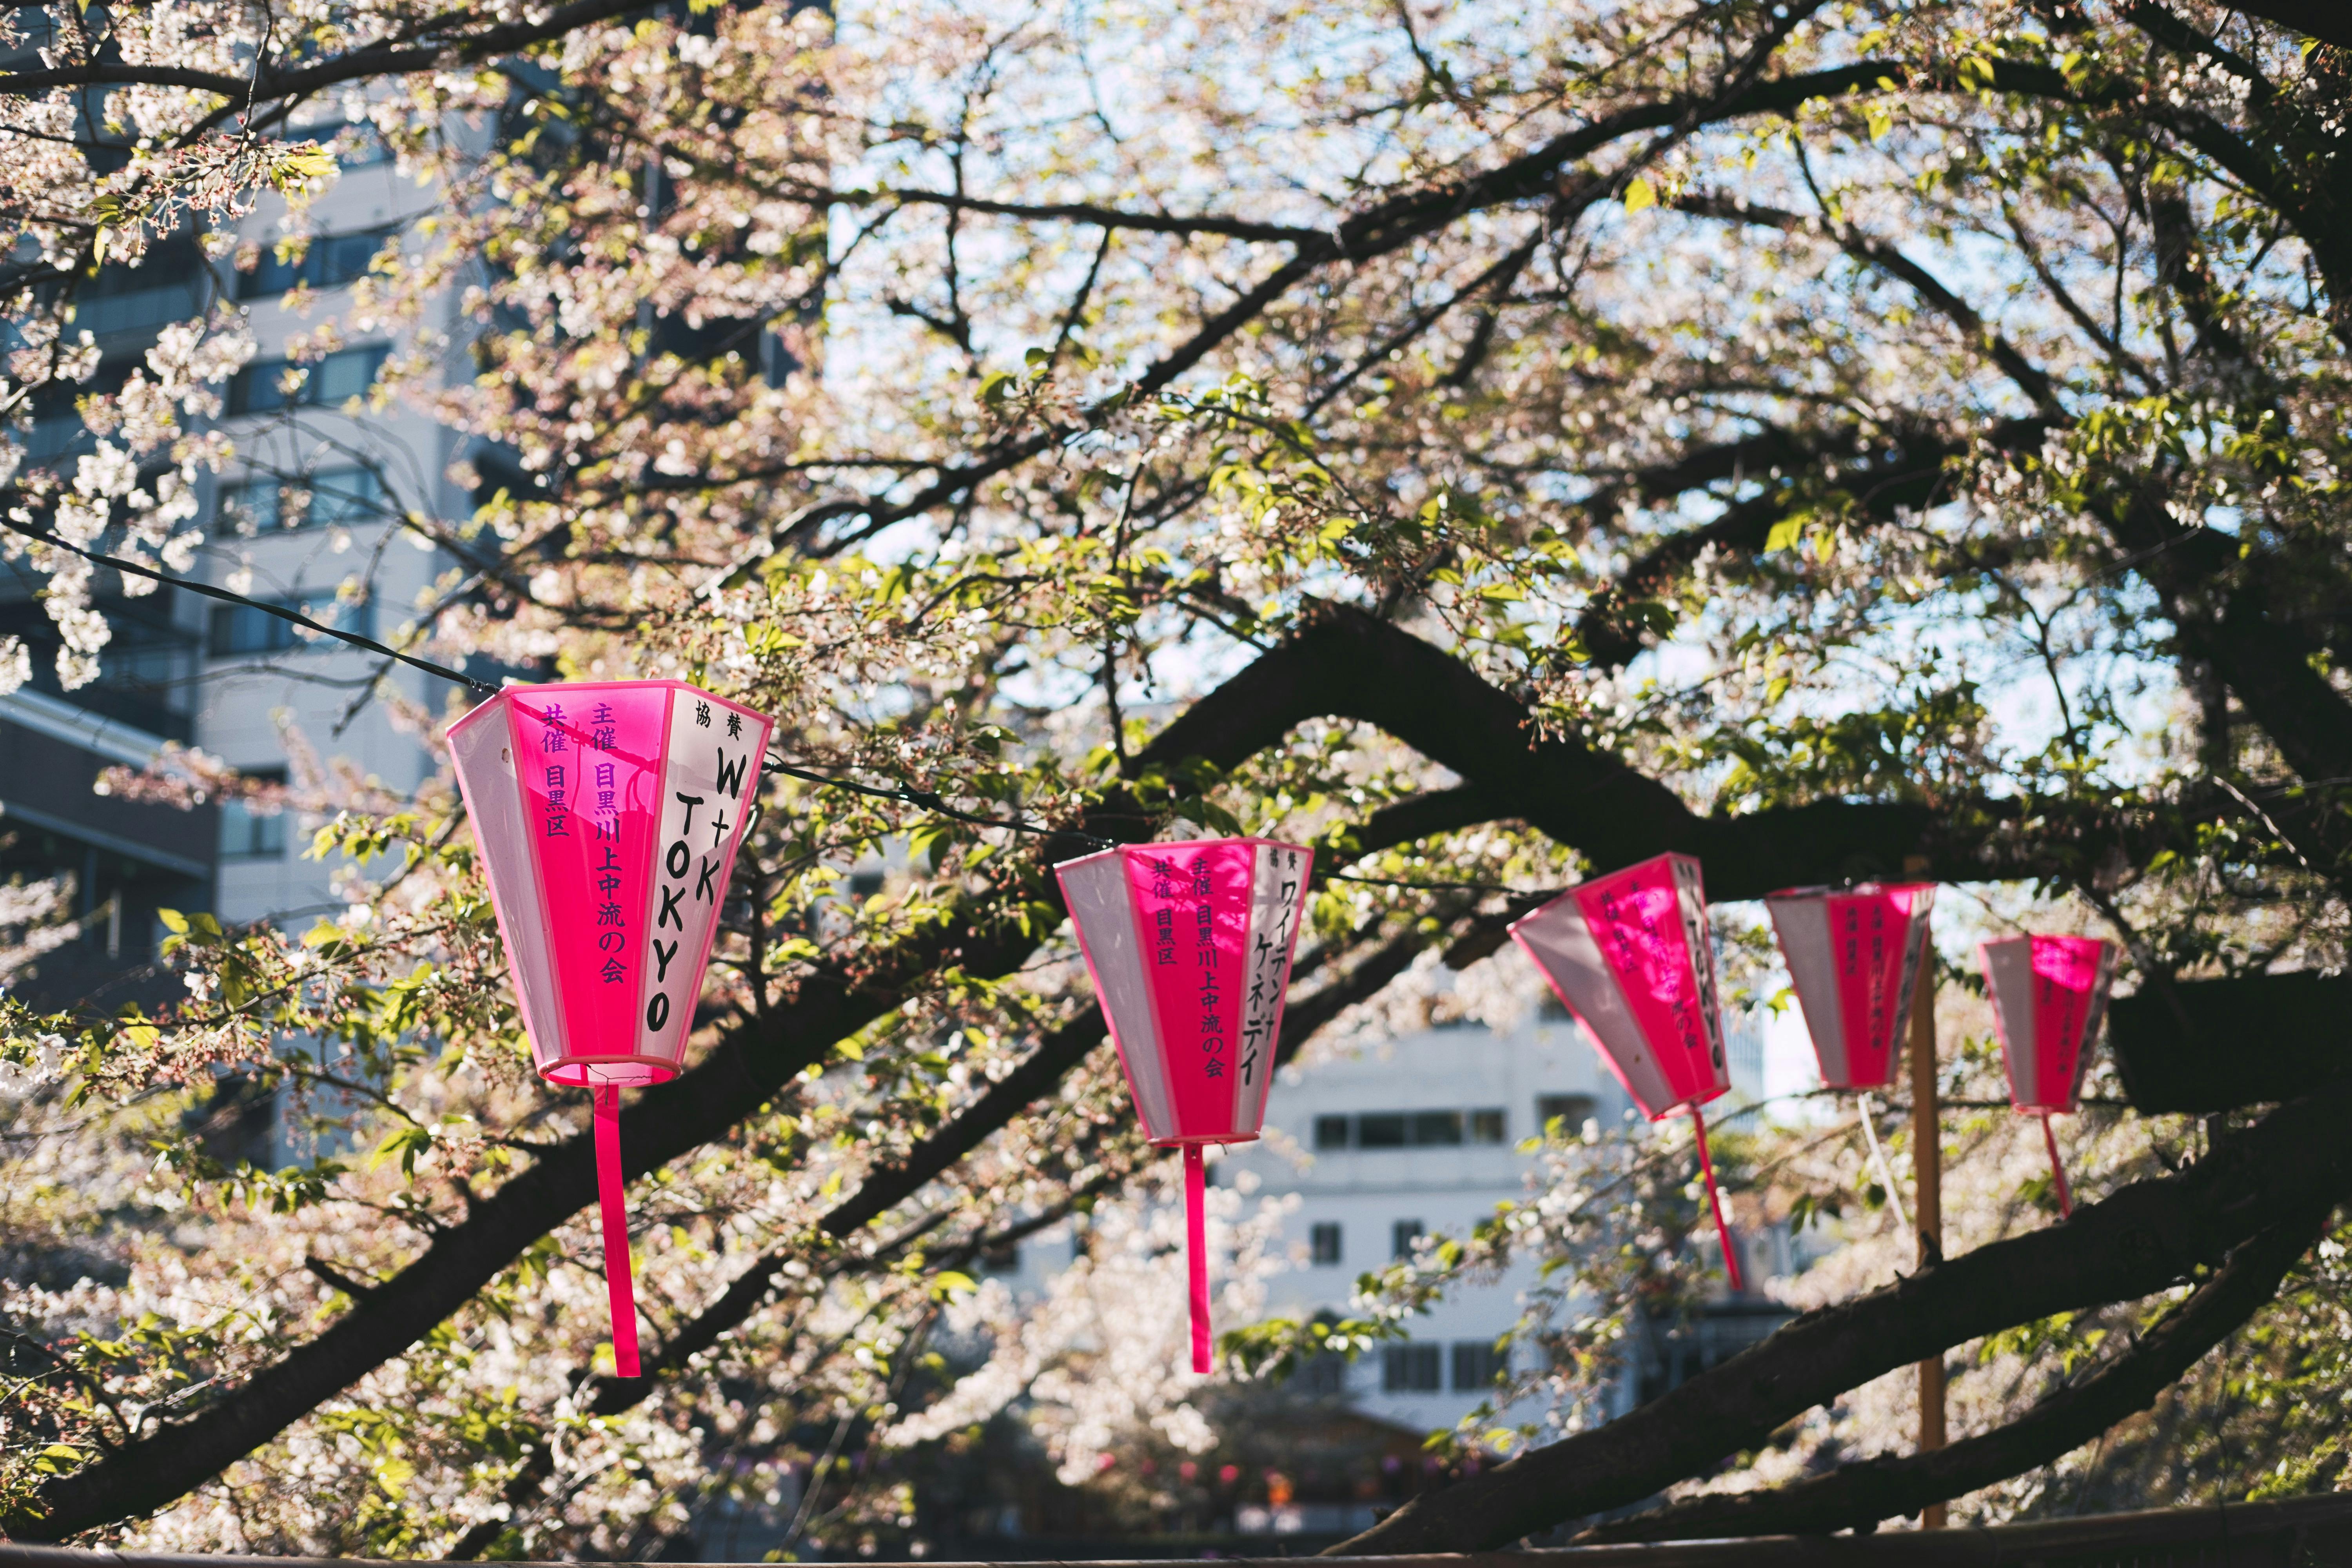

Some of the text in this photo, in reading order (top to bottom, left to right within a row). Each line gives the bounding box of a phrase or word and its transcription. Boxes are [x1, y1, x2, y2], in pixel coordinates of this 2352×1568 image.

[541, 703, 570, 837] 共催 目黒区
[696, 700, 742, 742] 協賛
[590, 702, 627, 984] 主催 目黒川上中流の会
[647, 792, 704, 1031] TOKYO
[1153, 862, 1177, 965] 共催 目黒区
[1192, 858, 1225, 1078] 主催 目黒川上中流の会
